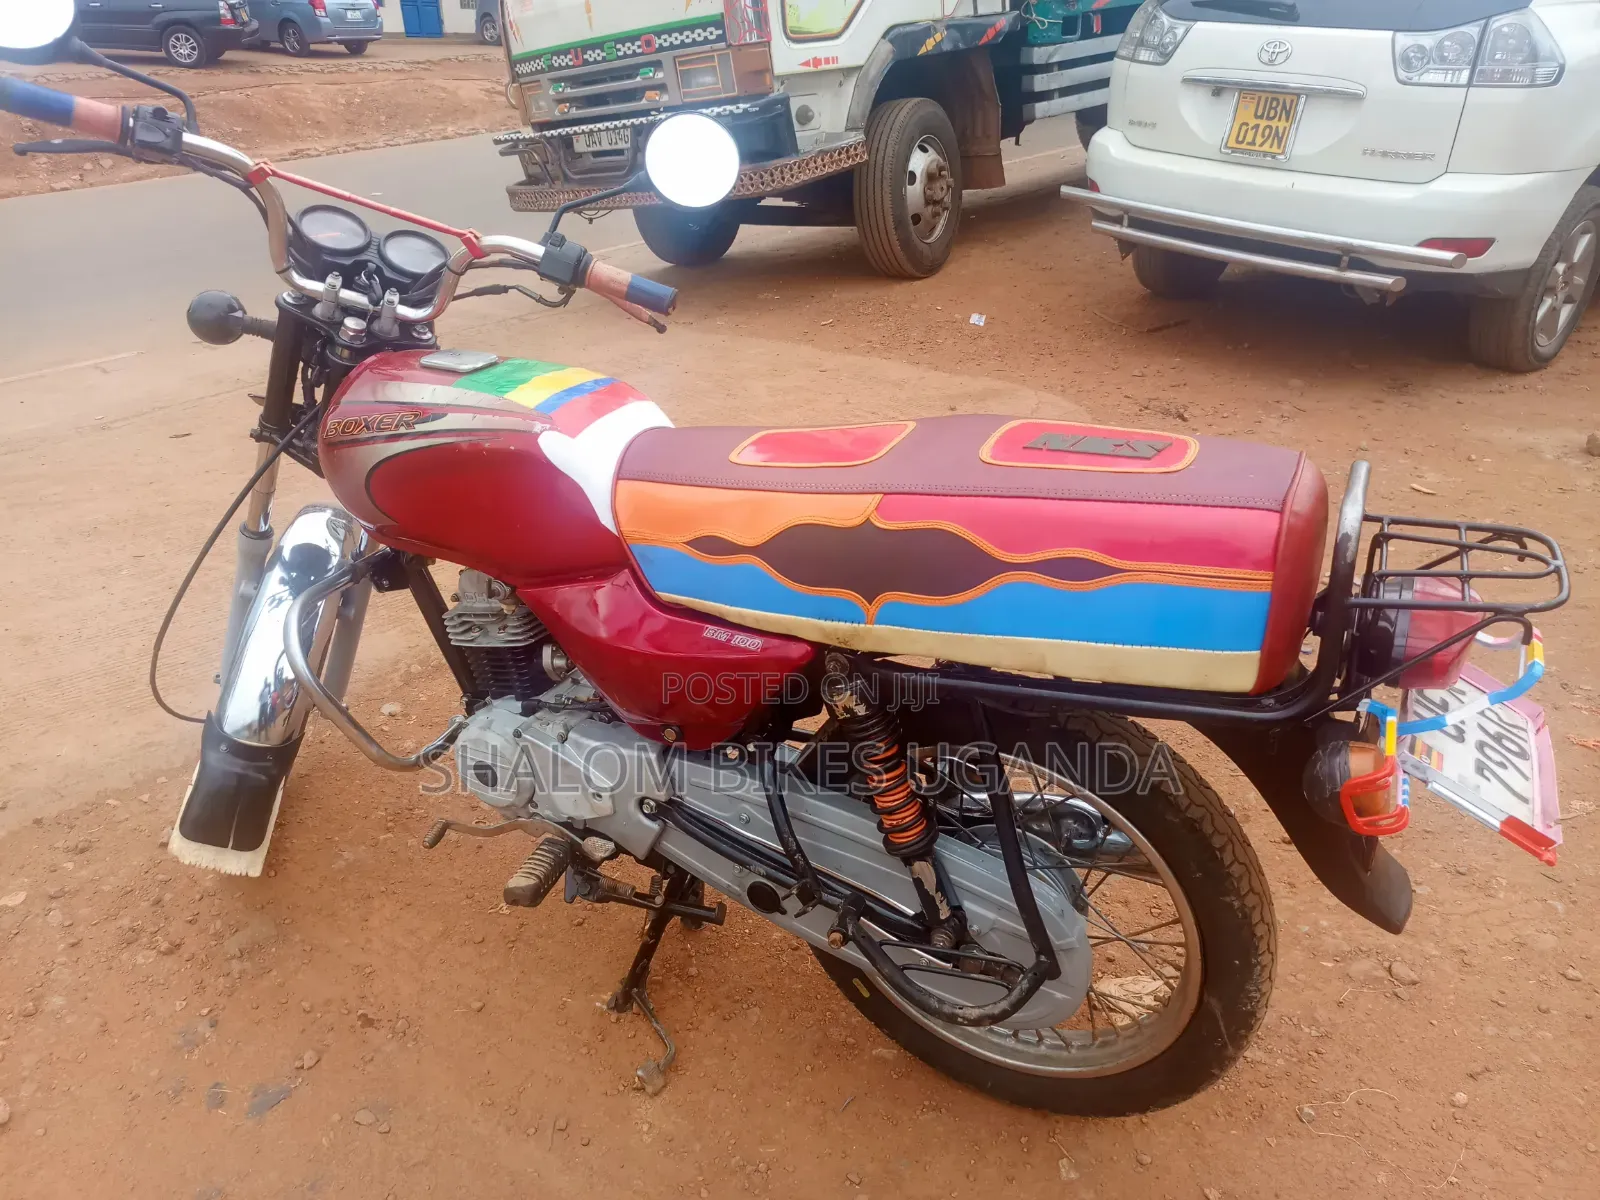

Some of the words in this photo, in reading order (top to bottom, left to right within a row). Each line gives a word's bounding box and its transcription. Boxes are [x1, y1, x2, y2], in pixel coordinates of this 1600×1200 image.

[543, 34, 656, 71] FUSO
[1254, 95, 1294, 123] UBN
[1235, 121, 1287, 149] 019N
[324, 411, 422, 439] BOXER
[704, 626, 731, 642] BM
[731, 635, 762, 651] 100
[1474, 707, 1530, 805] 796R
